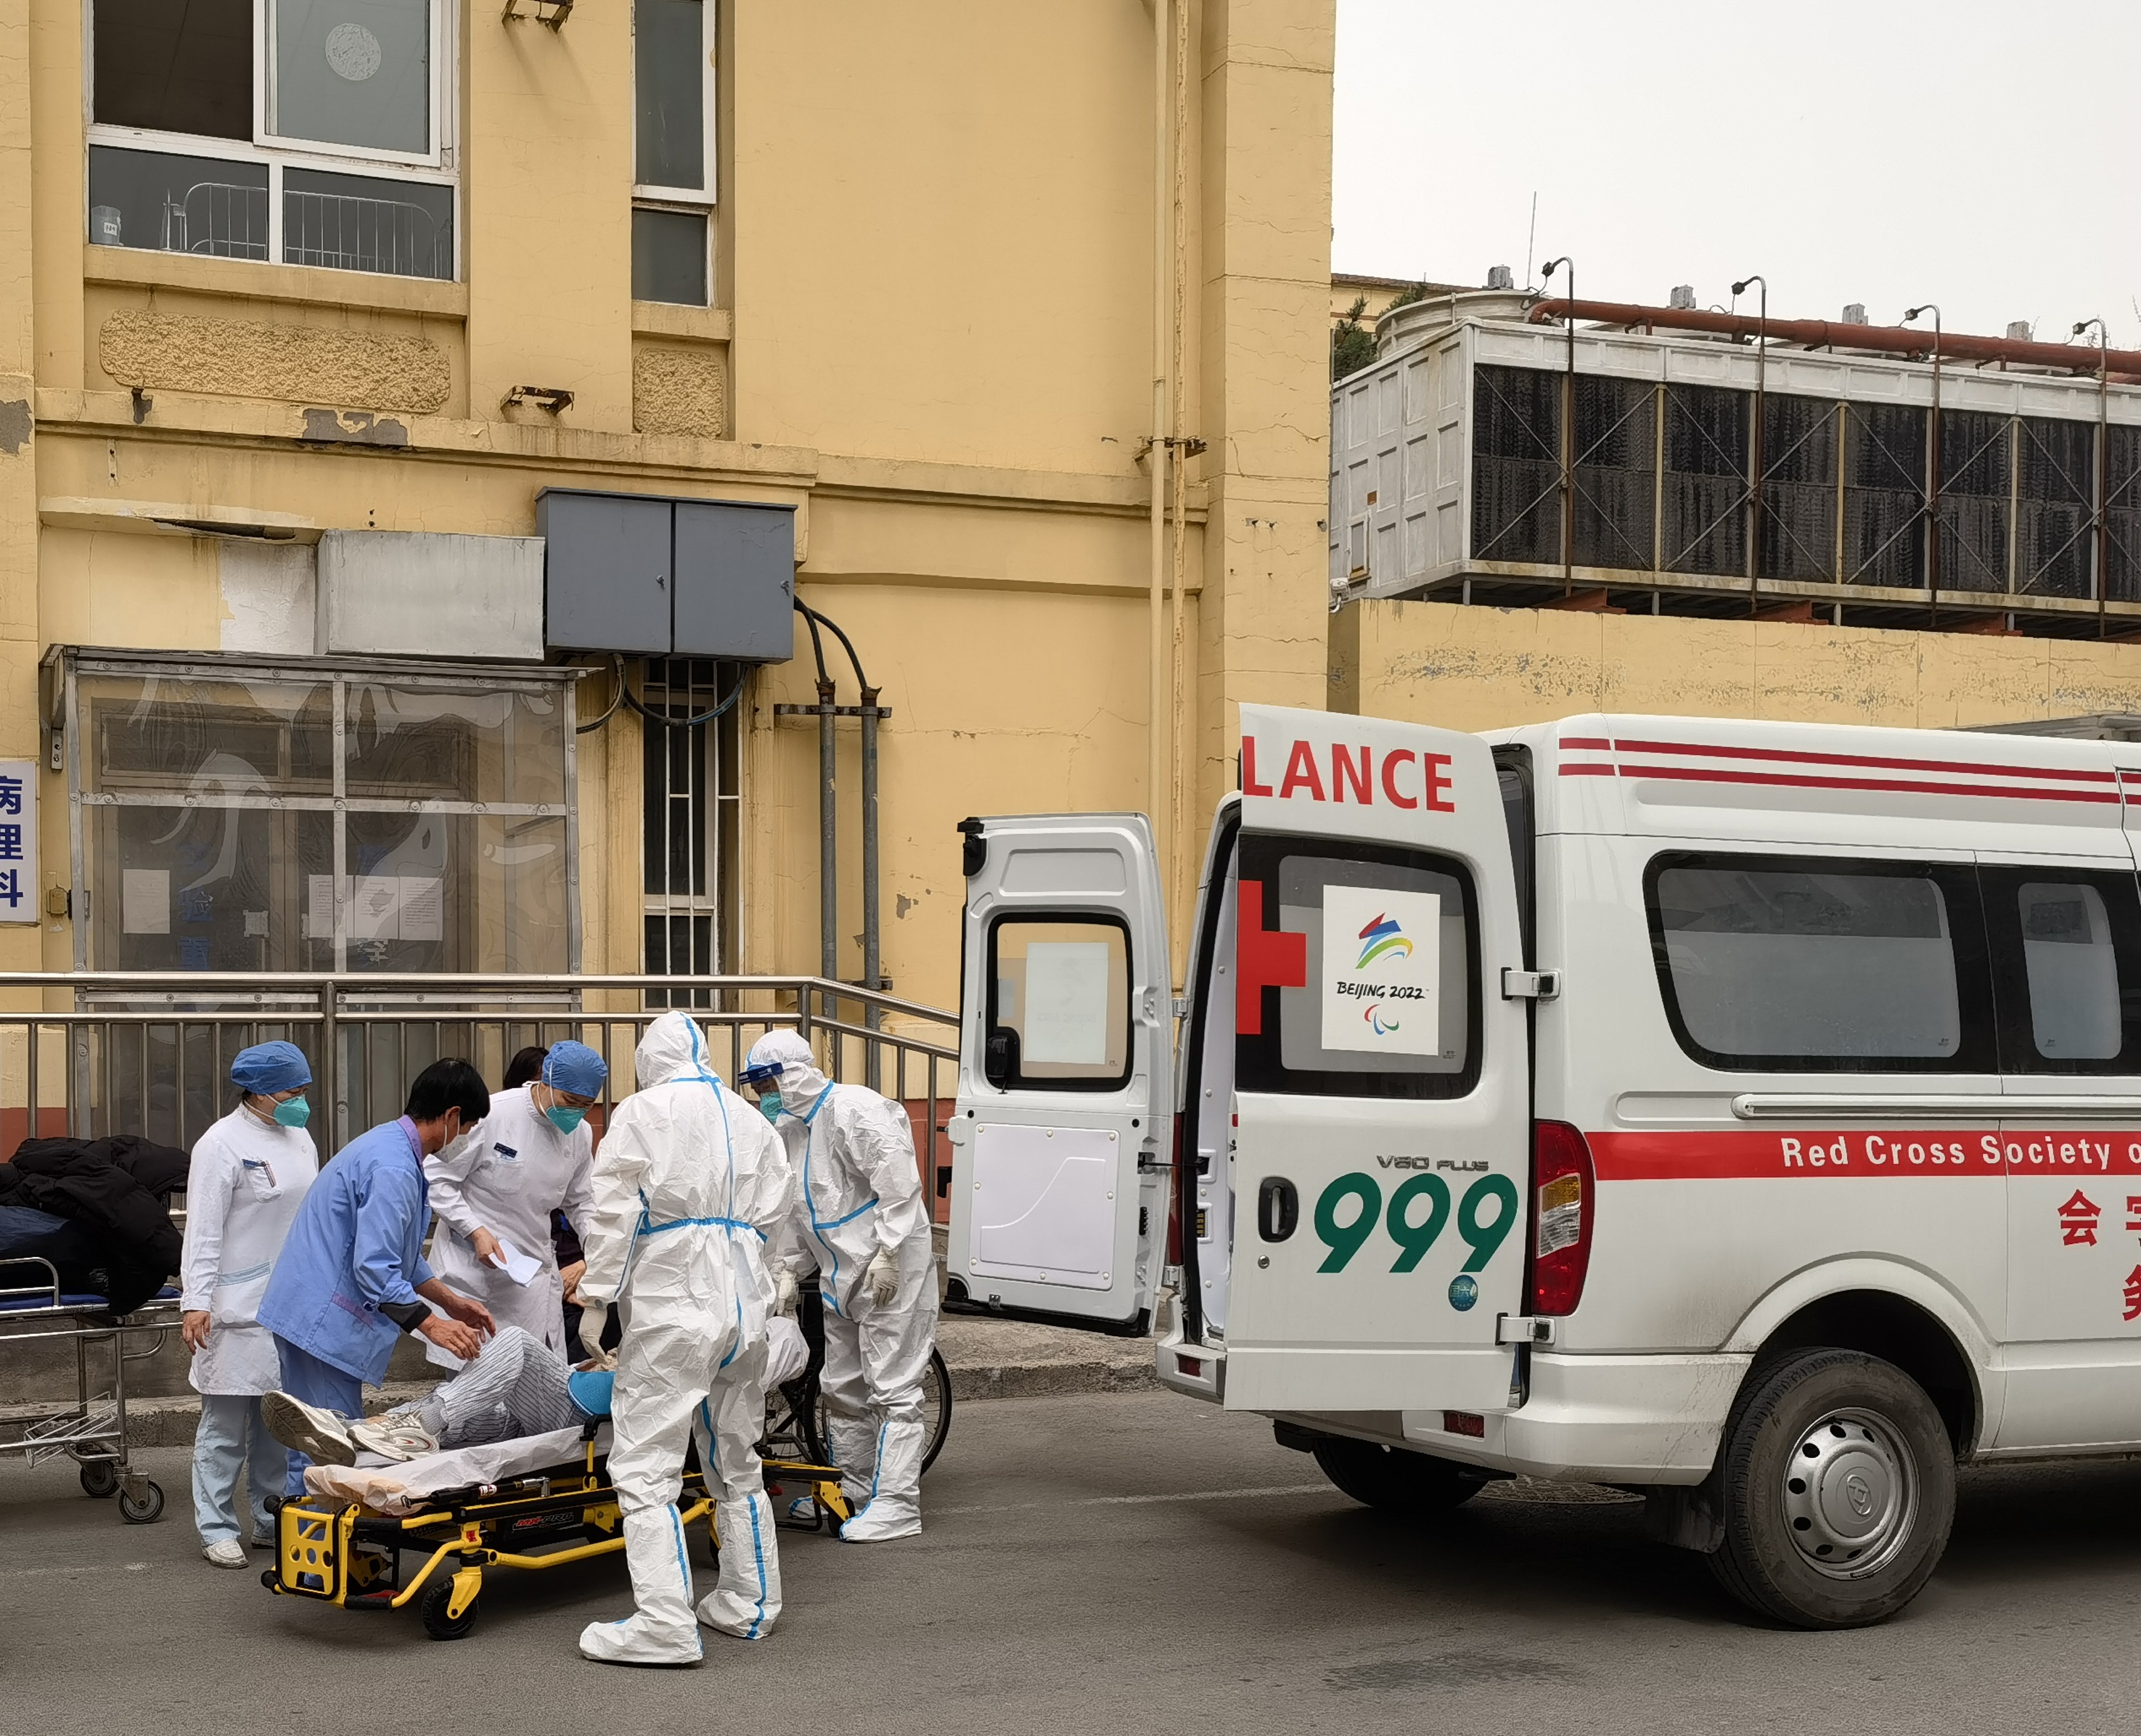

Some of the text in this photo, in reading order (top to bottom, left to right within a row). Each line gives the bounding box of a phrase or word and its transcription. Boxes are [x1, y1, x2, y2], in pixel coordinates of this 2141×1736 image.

[1242, 736, 1455, 813] LANCE
[1337, 981, 1426, 1000] BEIJING 2022
[1376, 1155, 1489, 1171] V80 PLUS
[1781, 1136, 1849, 1167] Red
[1865, 1135, 1965, 1165] Cross
[1981, 1134, 2111, 1170] Society
[1314, 1172, 1518, 1274] 999
